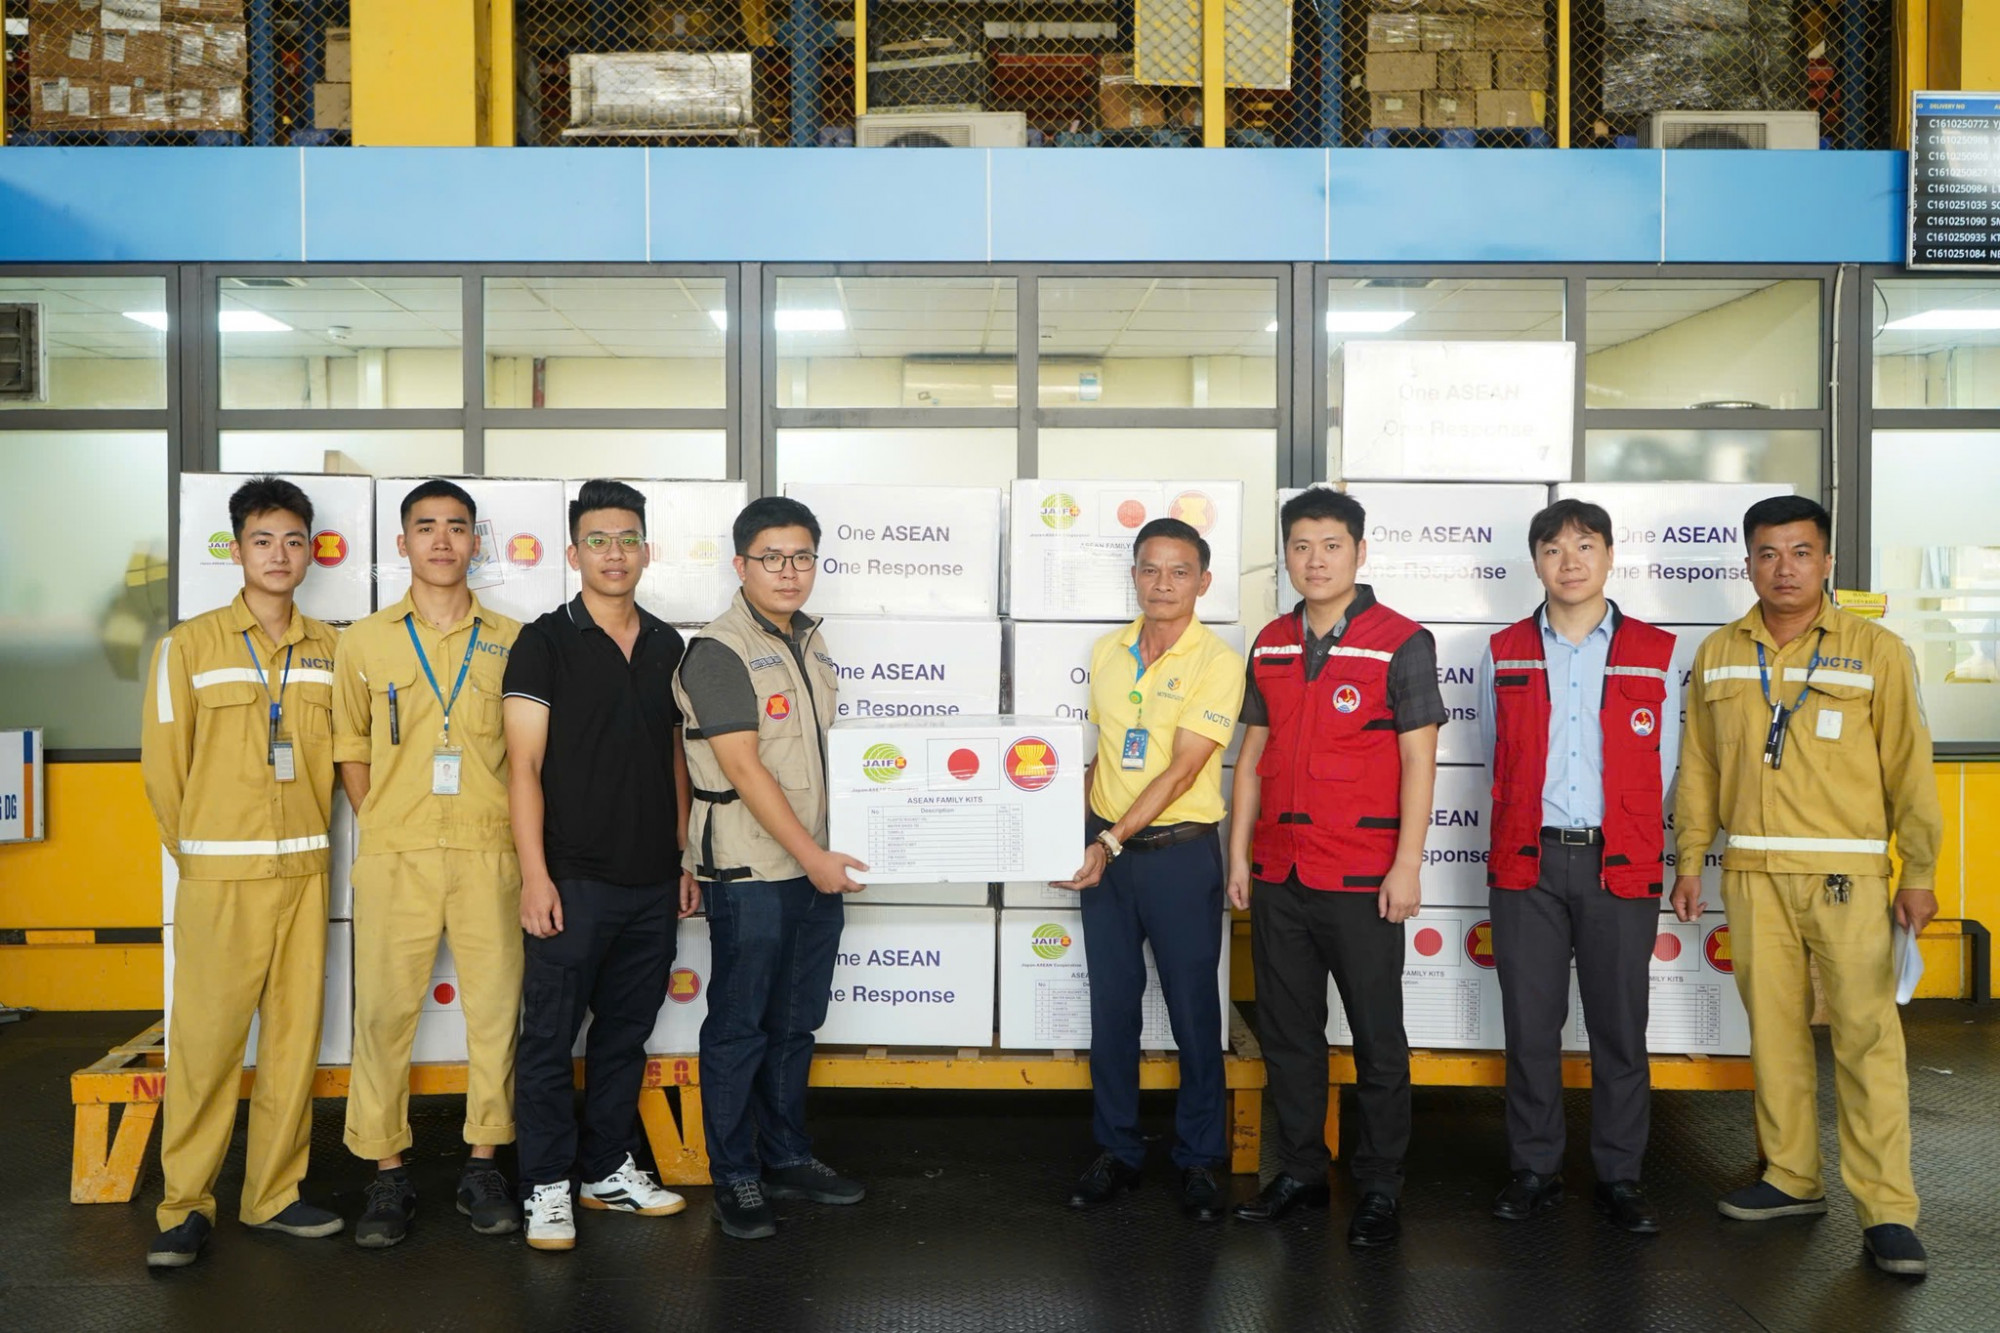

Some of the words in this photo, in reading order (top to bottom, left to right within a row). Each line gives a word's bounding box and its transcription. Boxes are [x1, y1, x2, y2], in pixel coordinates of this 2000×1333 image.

[1929, 119, 1989, 128] C1610250772
[1928, 184, 1987, 193] C1610250984
[1927, 200, 1987, 210] C1610251035
[1927, 216, 1986, 226] C1610251090
[1927, 233, 1986, 242] C1610250935
[1926, 249, 1986, 258] C1610251084
[1449, 384, 1520, 400] ASEAN
[1430, 420, 1534, 440] Response
[838, 524, 876, 540] One
[881, 525, 950, 542] ASEAN
[1374, 526, 1412, 542] One
[1419, 526, 1492, 543] ASEAN
[1616, 527, 1656, 543] One
[1662, 526, 1737, 543] ASEAN
[823, 558, 861, 574] One
[868, 559, 963, 578] Response
[1404, 562, 1506, 584] Response
[1648, 563, 1750, 583] Response
[1816, 656, 1863, 670] NCTS
[871, 663, 945, 681] ASEAN
[1437, 668, 1474, 684] EAN
[857, 699, 960, 716] Response
[1203, 710, 1231, 728] NCTS
[862, 759, 893, 767] JAIF
[5, 794, 17, 820] DG
[1428, 810, 1479, 827] EAN
[1422, 849, 1490, 865] sponse
[836, 952, 860, 967] ne
[867, 950, 940, 967] ASEAN
[852, 985, 955, 1006] Response
[133, 1075, 166, 1100] N
